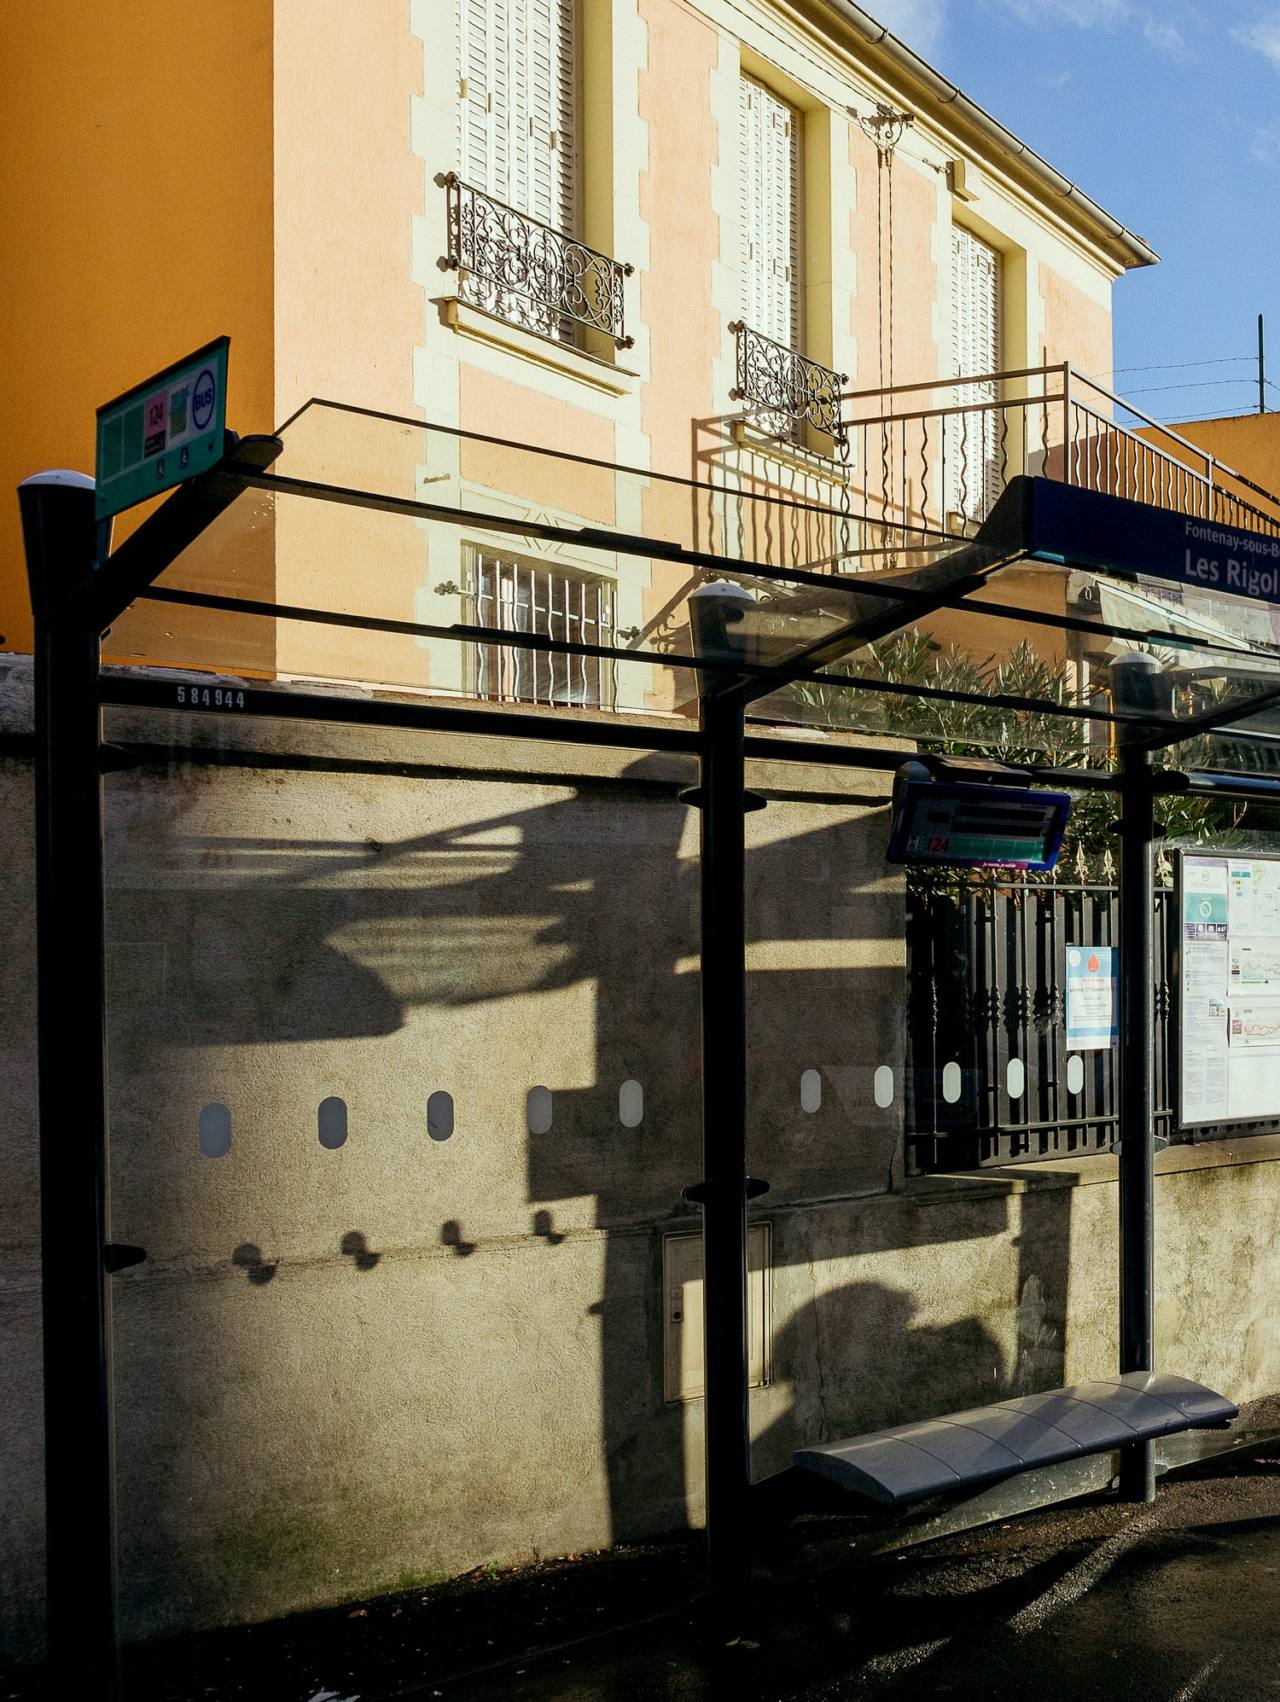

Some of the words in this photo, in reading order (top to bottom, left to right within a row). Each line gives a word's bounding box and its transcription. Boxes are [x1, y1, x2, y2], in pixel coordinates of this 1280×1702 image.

[194, 388, 212, 411] BUS
[1185, 548, 1220, 582] Les
[177, 686, 245, 708] 584944
